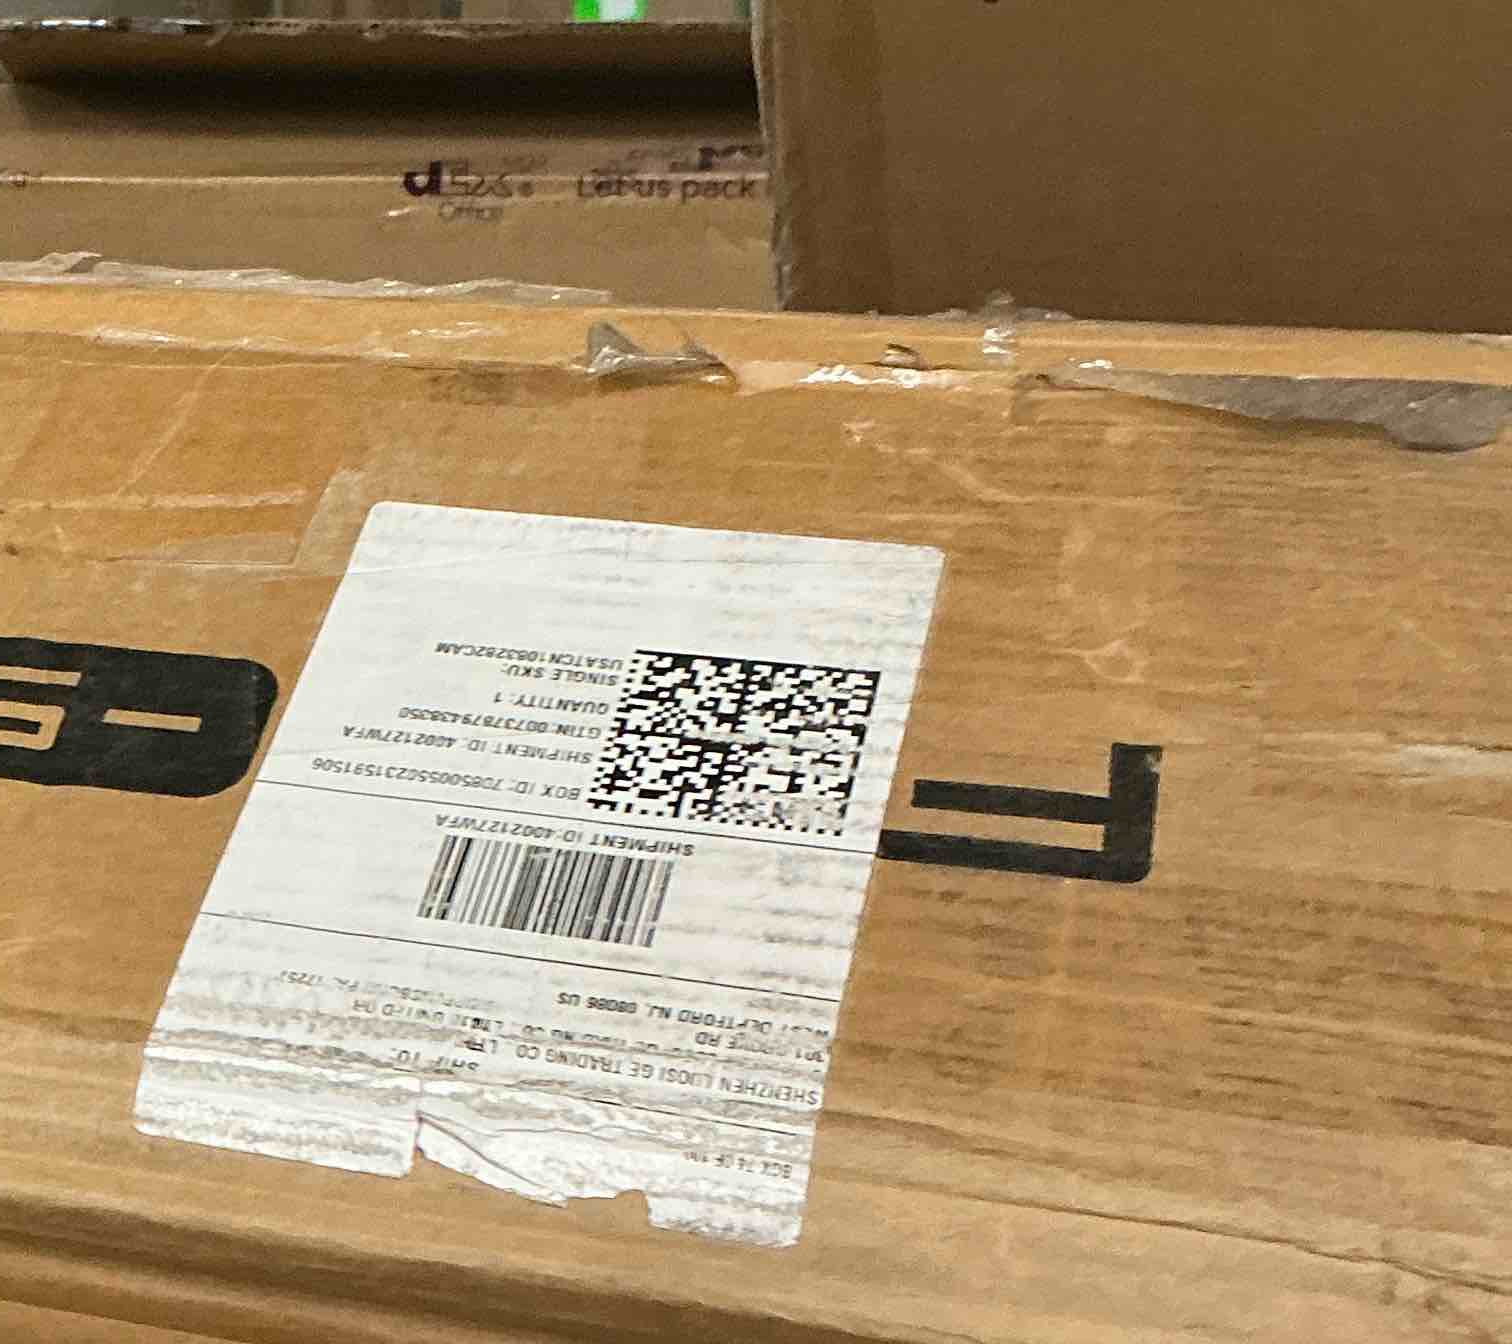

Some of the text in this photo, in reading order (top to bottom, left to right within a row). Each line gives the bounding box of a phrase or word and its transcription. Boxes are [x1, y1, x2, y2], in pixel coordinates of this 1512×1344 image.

[499, 663, 619, 687] SINGLE SKU:
[508, 692, 610, 716] QUANTITY:
[493, 739, 593, 765] SHIPMENT
[542, 782, 581, 801] BOX
[588, 832, 696, 857] SHIPMENT
[555, 992, 582, 1007] US
